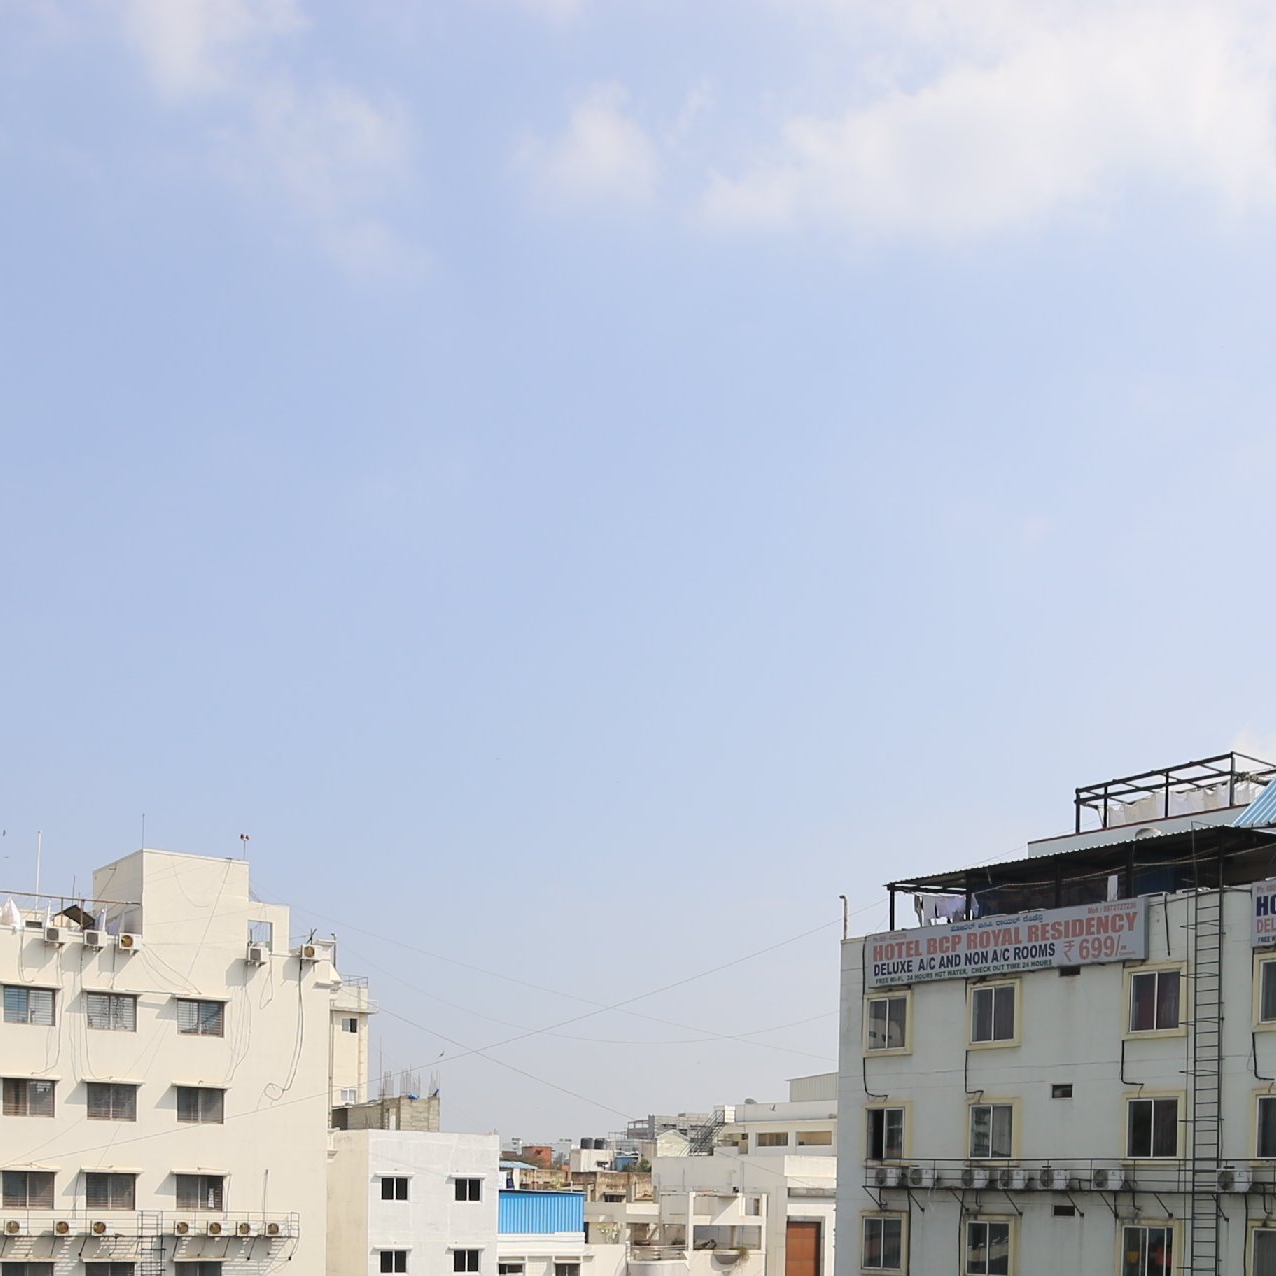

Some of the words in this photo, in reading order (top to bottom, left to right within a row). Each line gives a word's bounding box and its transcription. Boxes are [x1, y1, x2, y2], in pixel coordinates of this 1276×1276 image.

[872, 940, 923, 962] HOTEL
[926, 934, 962, 956] BCP
[966, 927, 1022, 950] ROYAL
[1027, 911, 1139, 943] RESIDENCY
[873, 960, 913, 977] DELUXE
[918, 957, 936, 972] A/C
[938, 953, 961, 969] AND
[964, 951, 989, 967] NON
[991, 948, 1011, 963] A/C
[1013, 942, 1056, 961] ROOMS
[971, 965, 992, 974] CHECK
[992, 964, 1004, 972] OUT
[1006, 962, 1020, 971] TIME
